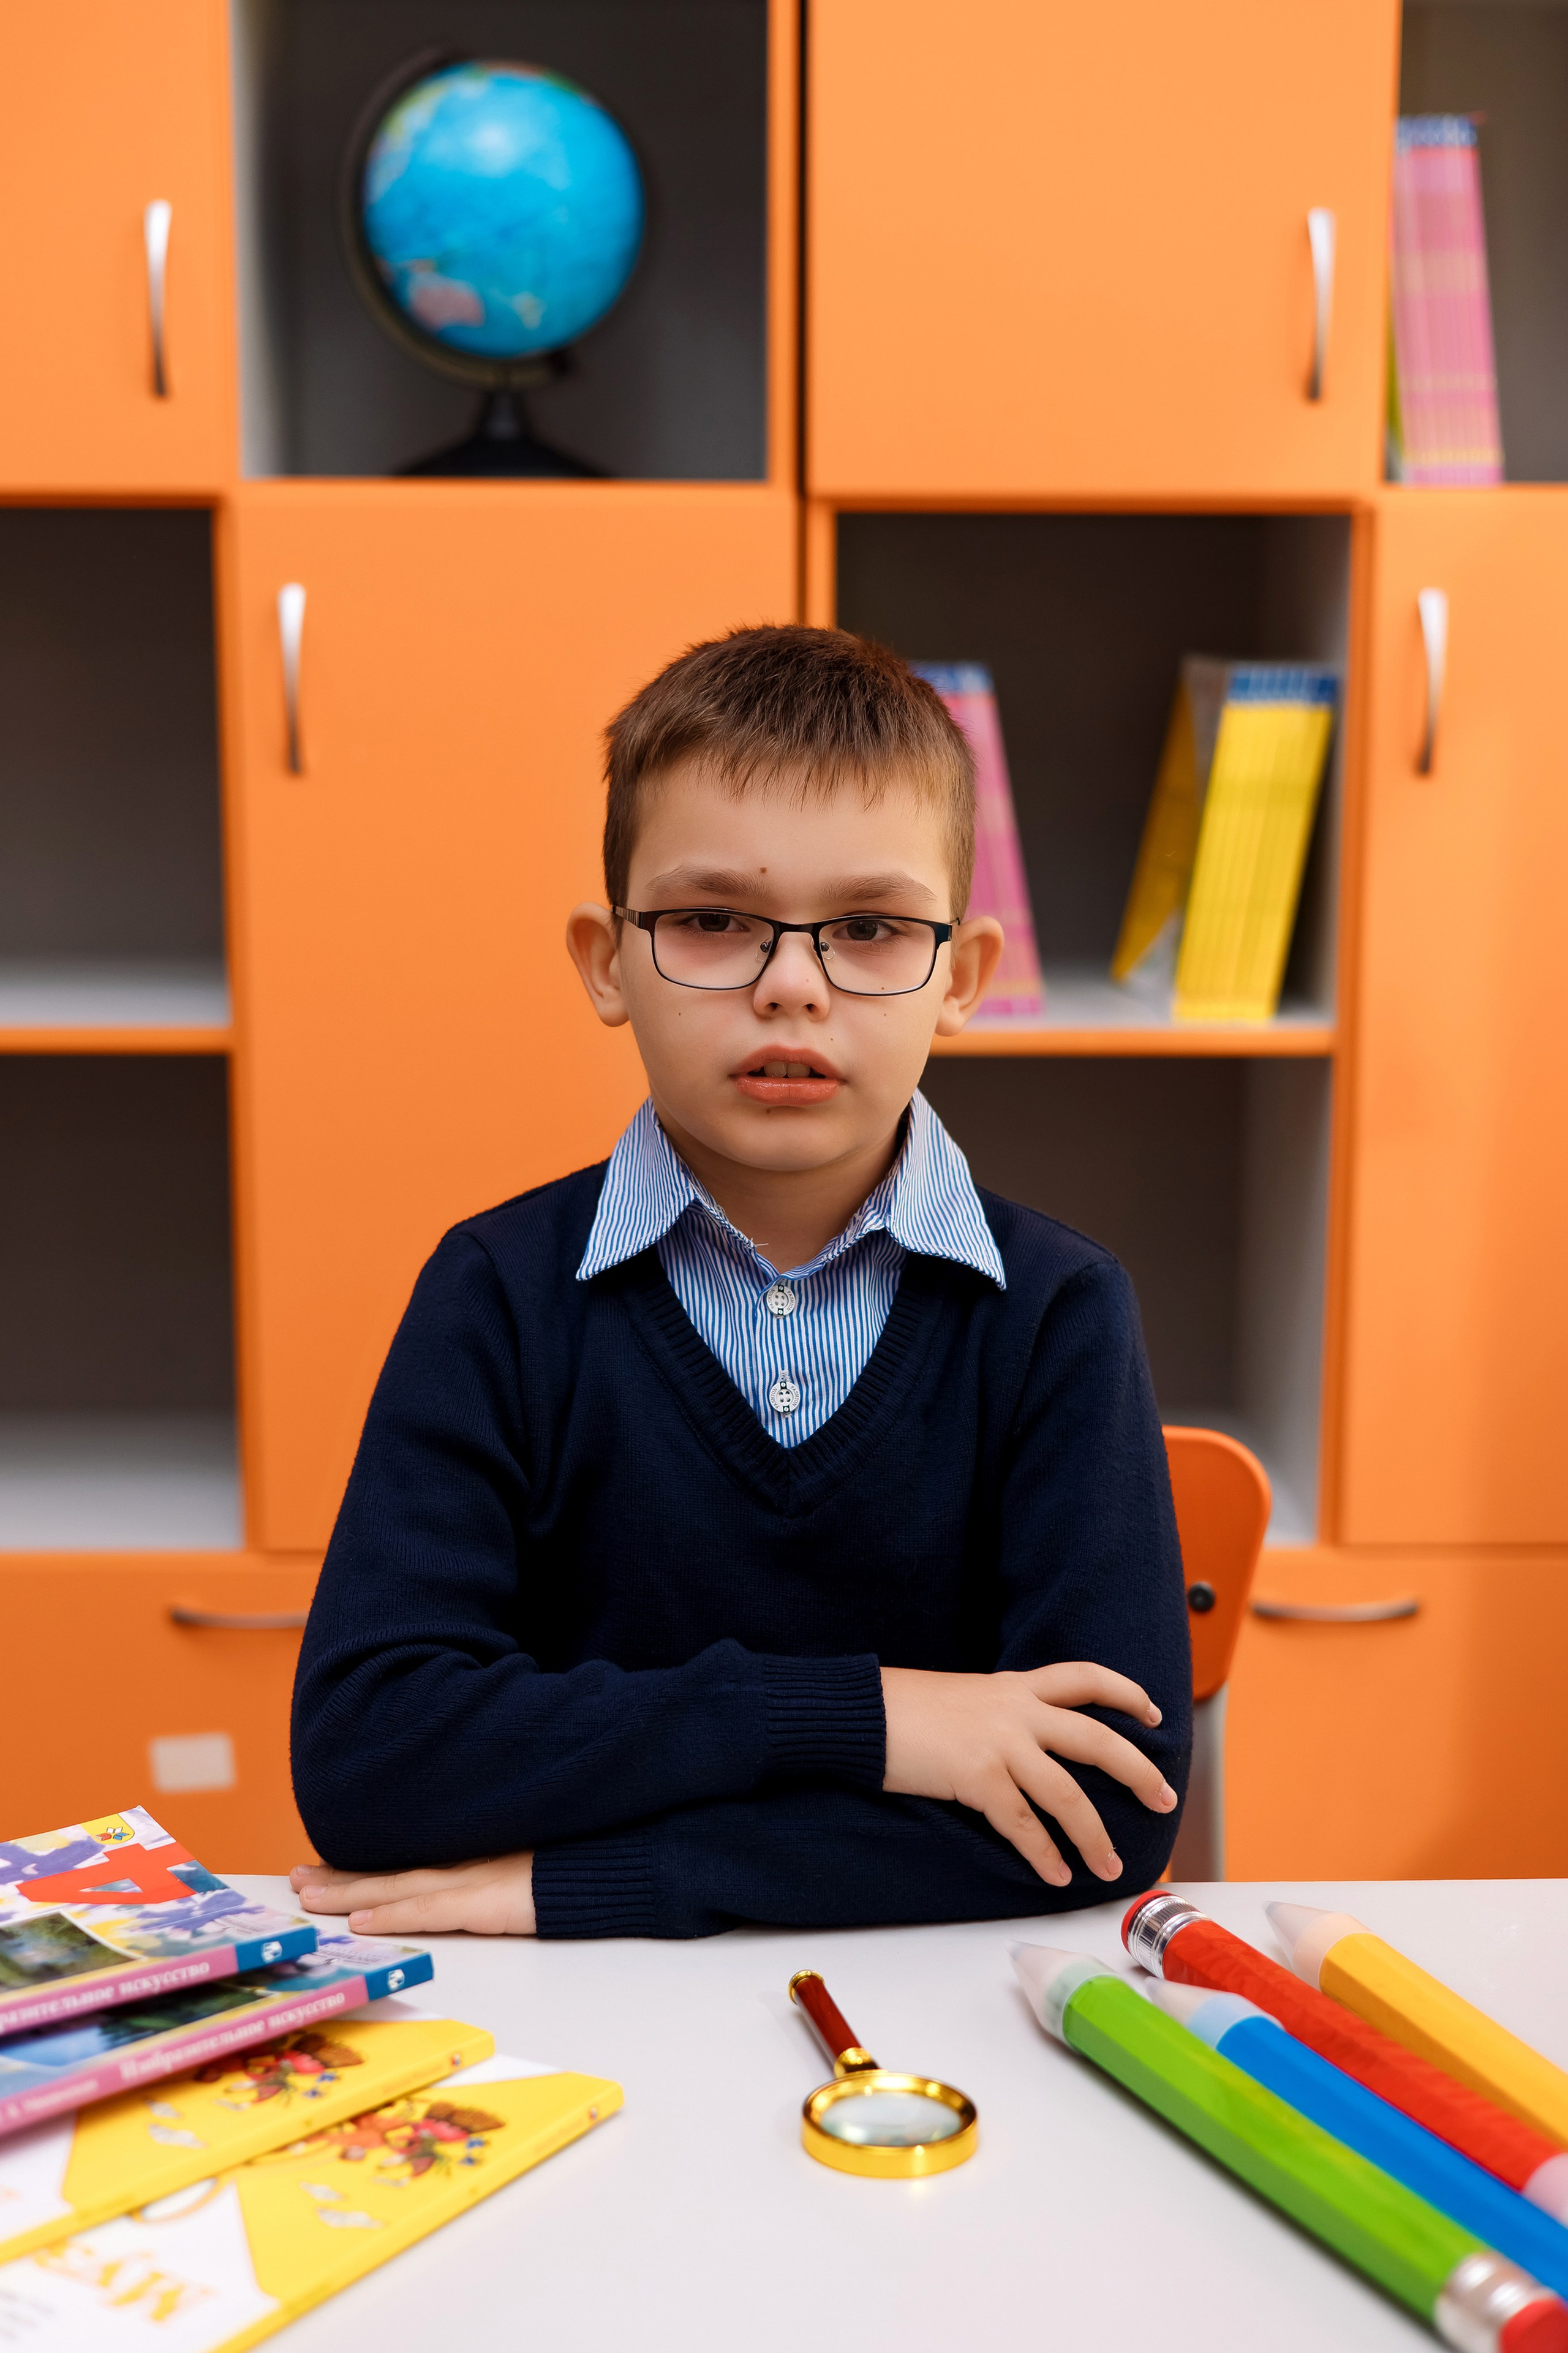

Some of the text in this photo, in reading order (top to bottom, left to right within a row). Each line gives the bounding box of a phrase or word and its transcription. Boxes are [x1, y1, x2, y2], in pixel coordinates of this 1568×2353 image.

[15, 1841, 197, 1905] 4
[118, 1962, 210, 1996] искусство
[119, 1992, 345, 2079] Изобразительное искусство
